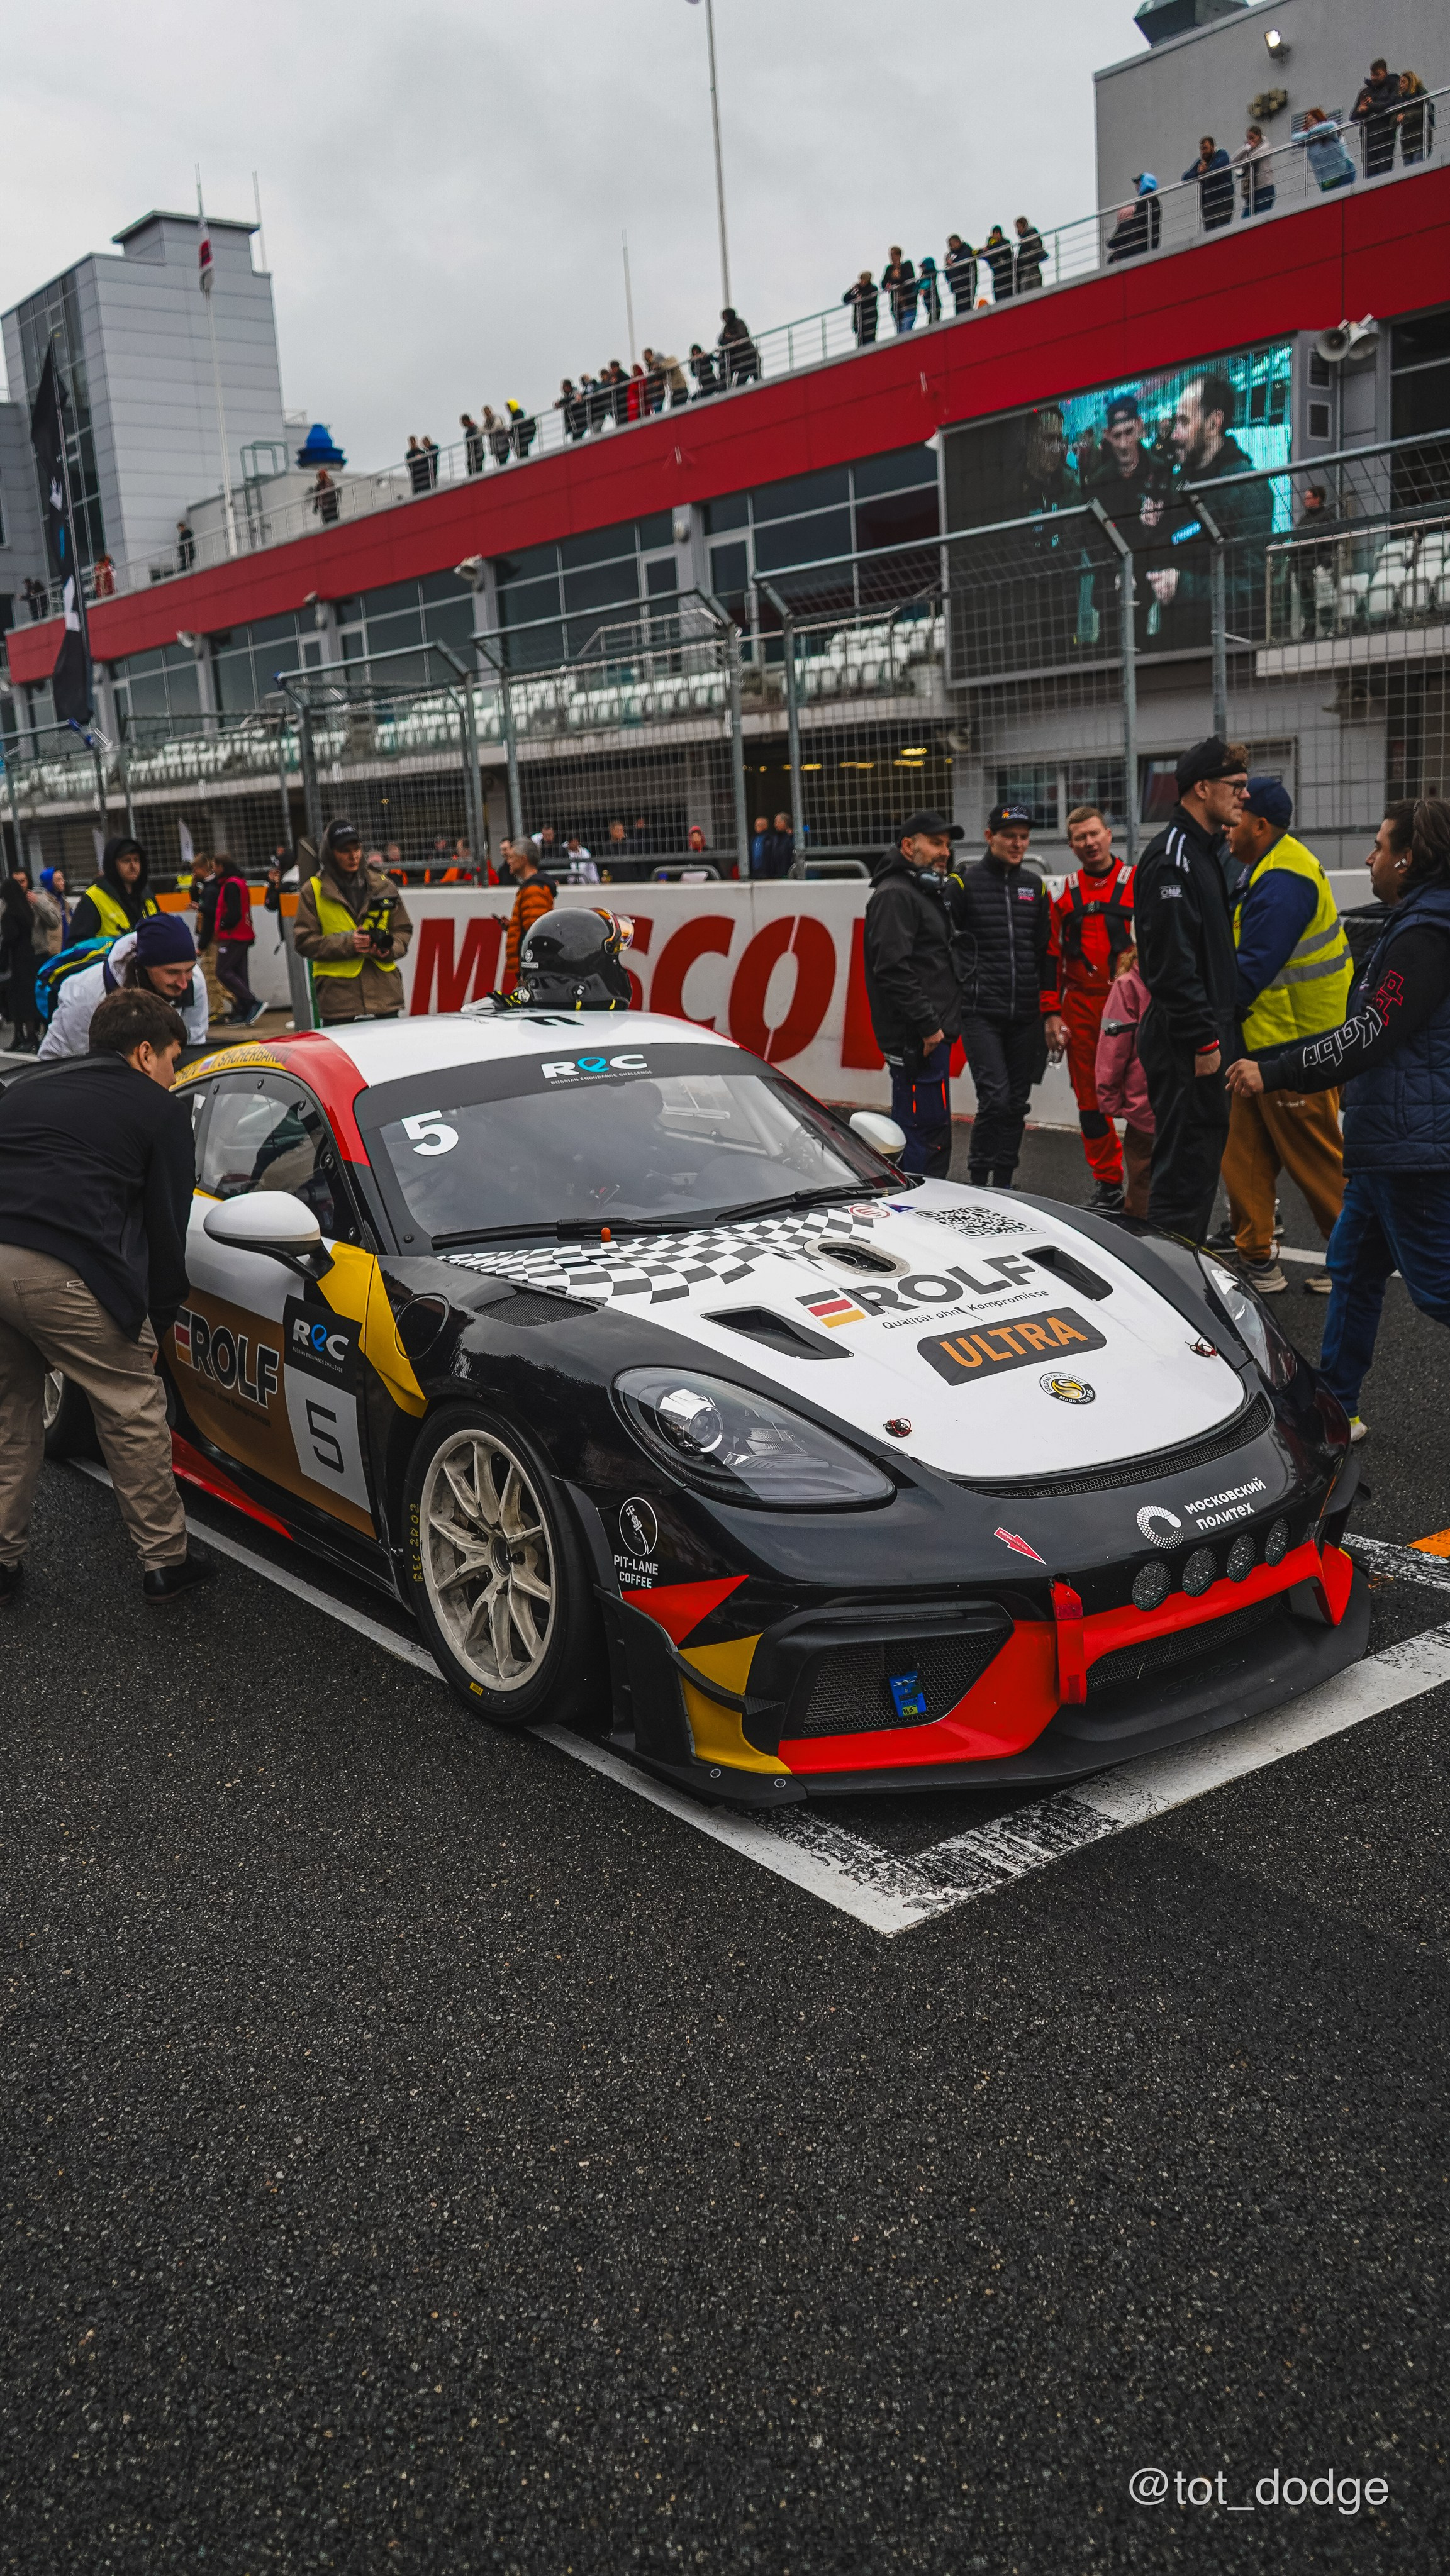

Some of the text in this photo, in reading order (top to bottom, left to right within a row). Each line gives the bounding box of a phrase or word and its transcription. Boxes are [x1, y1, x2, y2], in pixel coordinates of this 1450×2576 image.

[580, 1073, 618, 1081] ENDURANCE
[401, 1109, 459, 1156] 5
[839, 1255, 1037, 1317] ROLF
[882, 1314, 934, 1330] Qualität
[966, 1290, 1049, 1311] Kompromisse
[190, 1311, 280, 1409] ROLF
[940, 1316, 1088, 1368] ULTRA
[325, 1361, 343, 1373] CHALLENGE
[305, 1399, 345, 1474] 5
[614, 1554, 659, 1575] PIT-LANE
[619, 1571, 652, 1589] COFFEE
